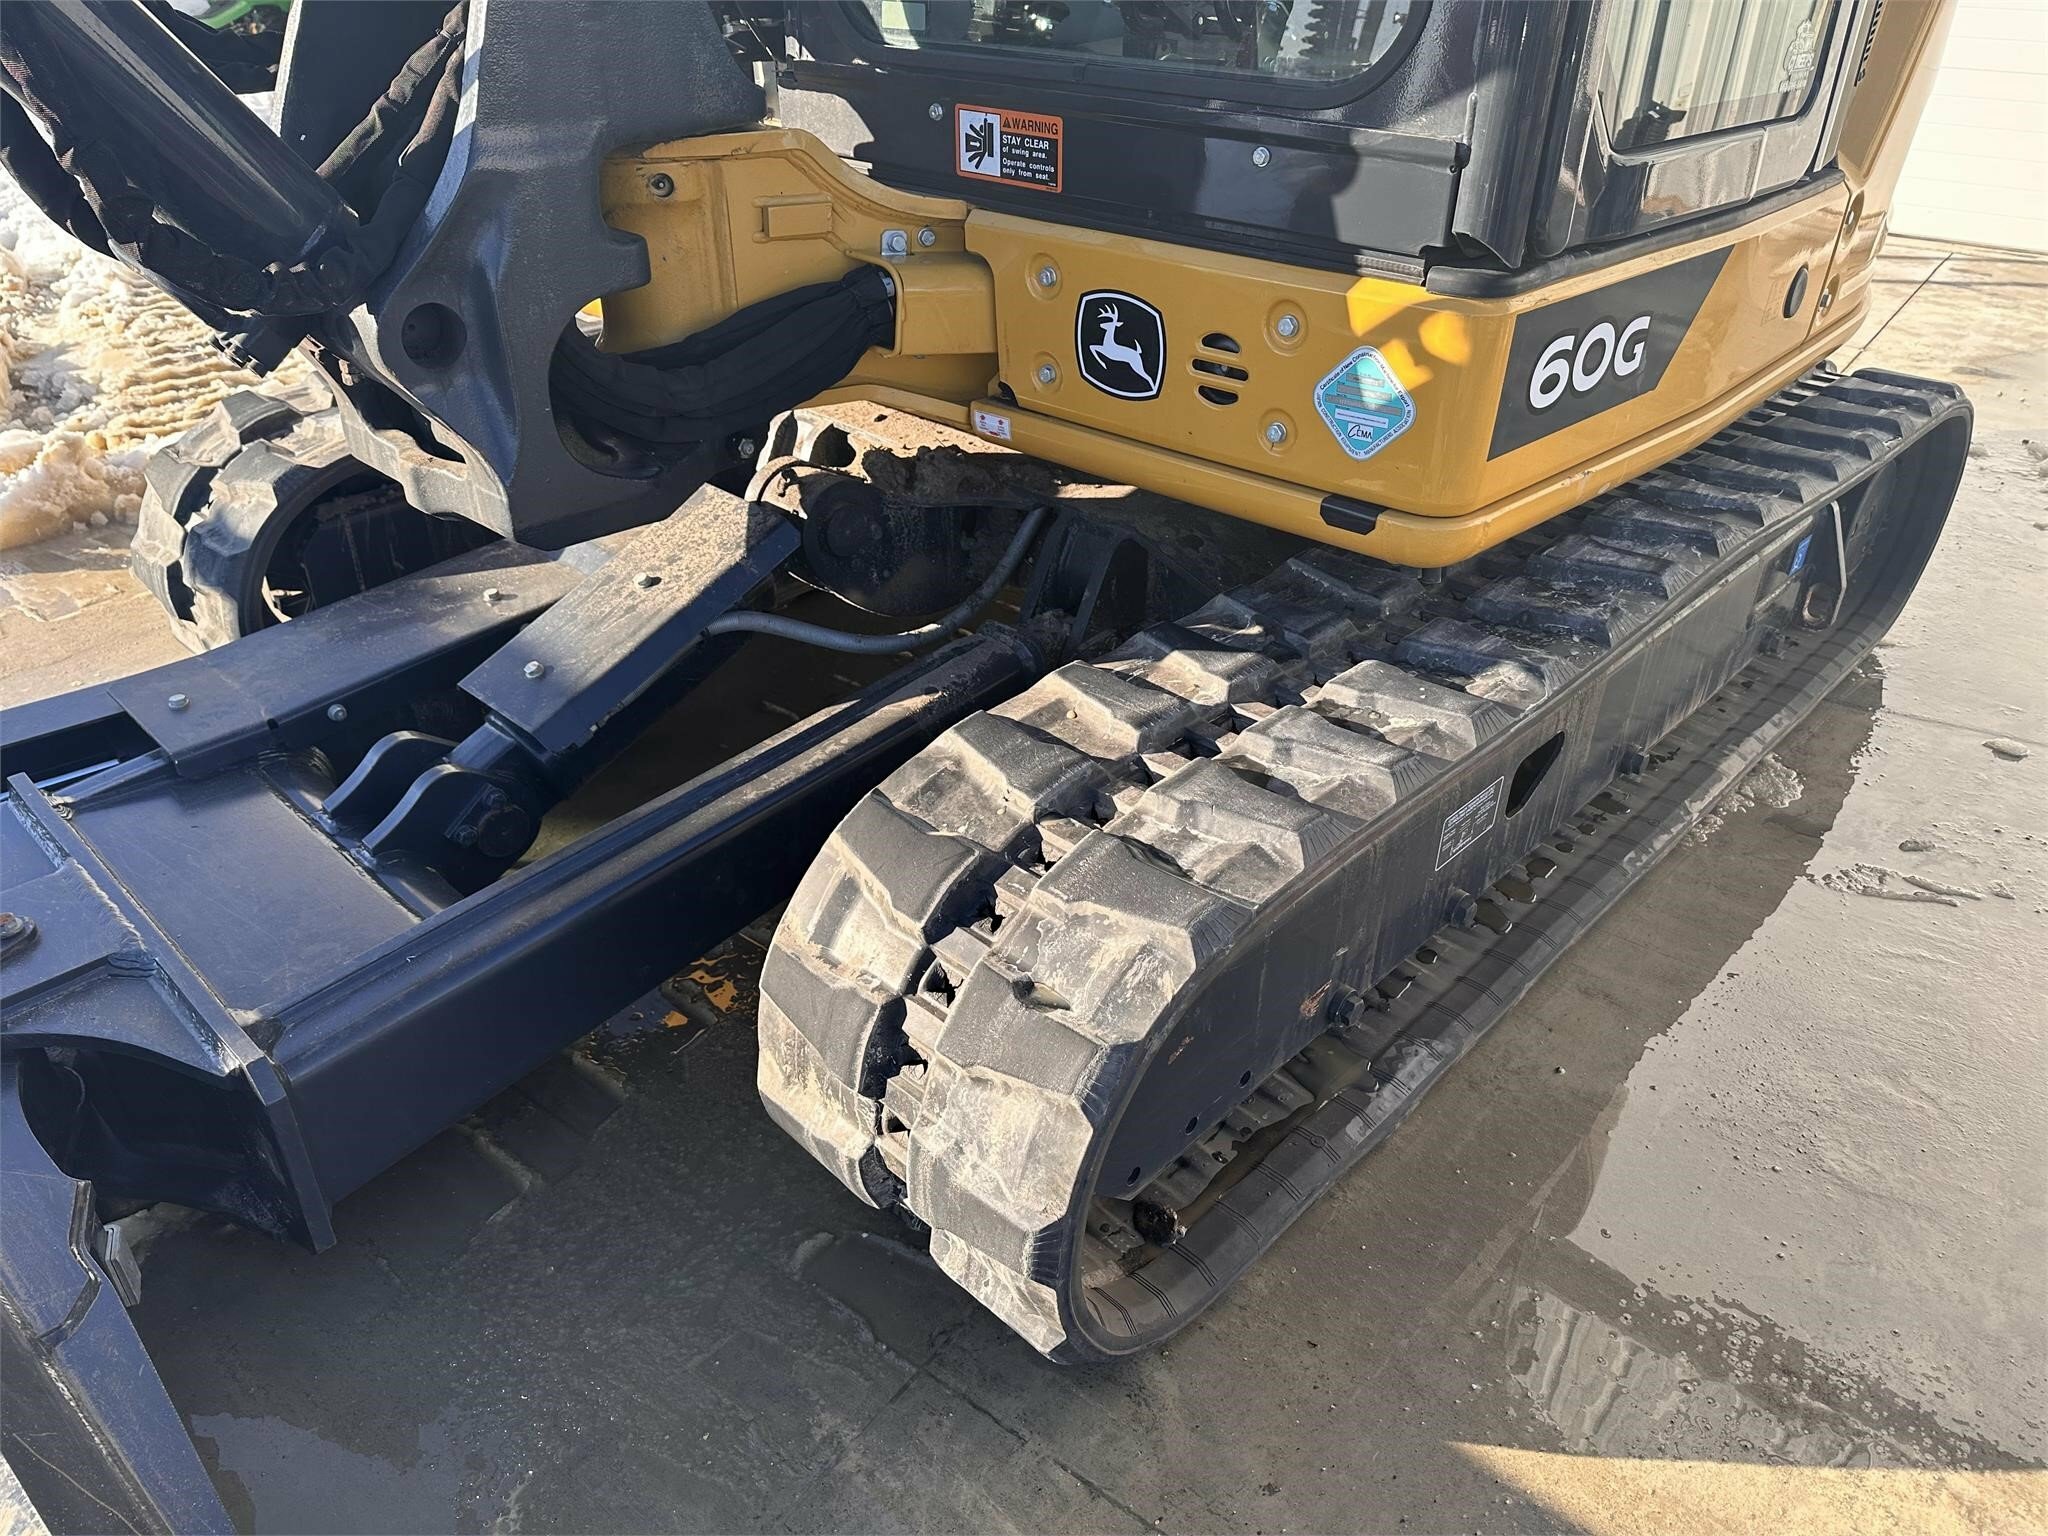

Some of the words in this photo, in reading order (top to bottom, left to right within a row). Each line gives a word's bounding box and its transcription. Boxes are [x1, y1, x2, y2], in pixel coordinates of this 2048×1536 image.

[1012, 117, 1058, 135] WARNING
[1002, 135, 1021, 145] STAY
[1025, 138, 1049, 149] CLEAR
[1012, 148, 1029, 158] swing
[1002, 158, 1026, 168] Operate
[1029, 163, 1055, 172] controls
[1002, 168, 1015, 176] only
[1019, 169, 1032, 177] from
[1530, 316, 1651, 408] 60G
